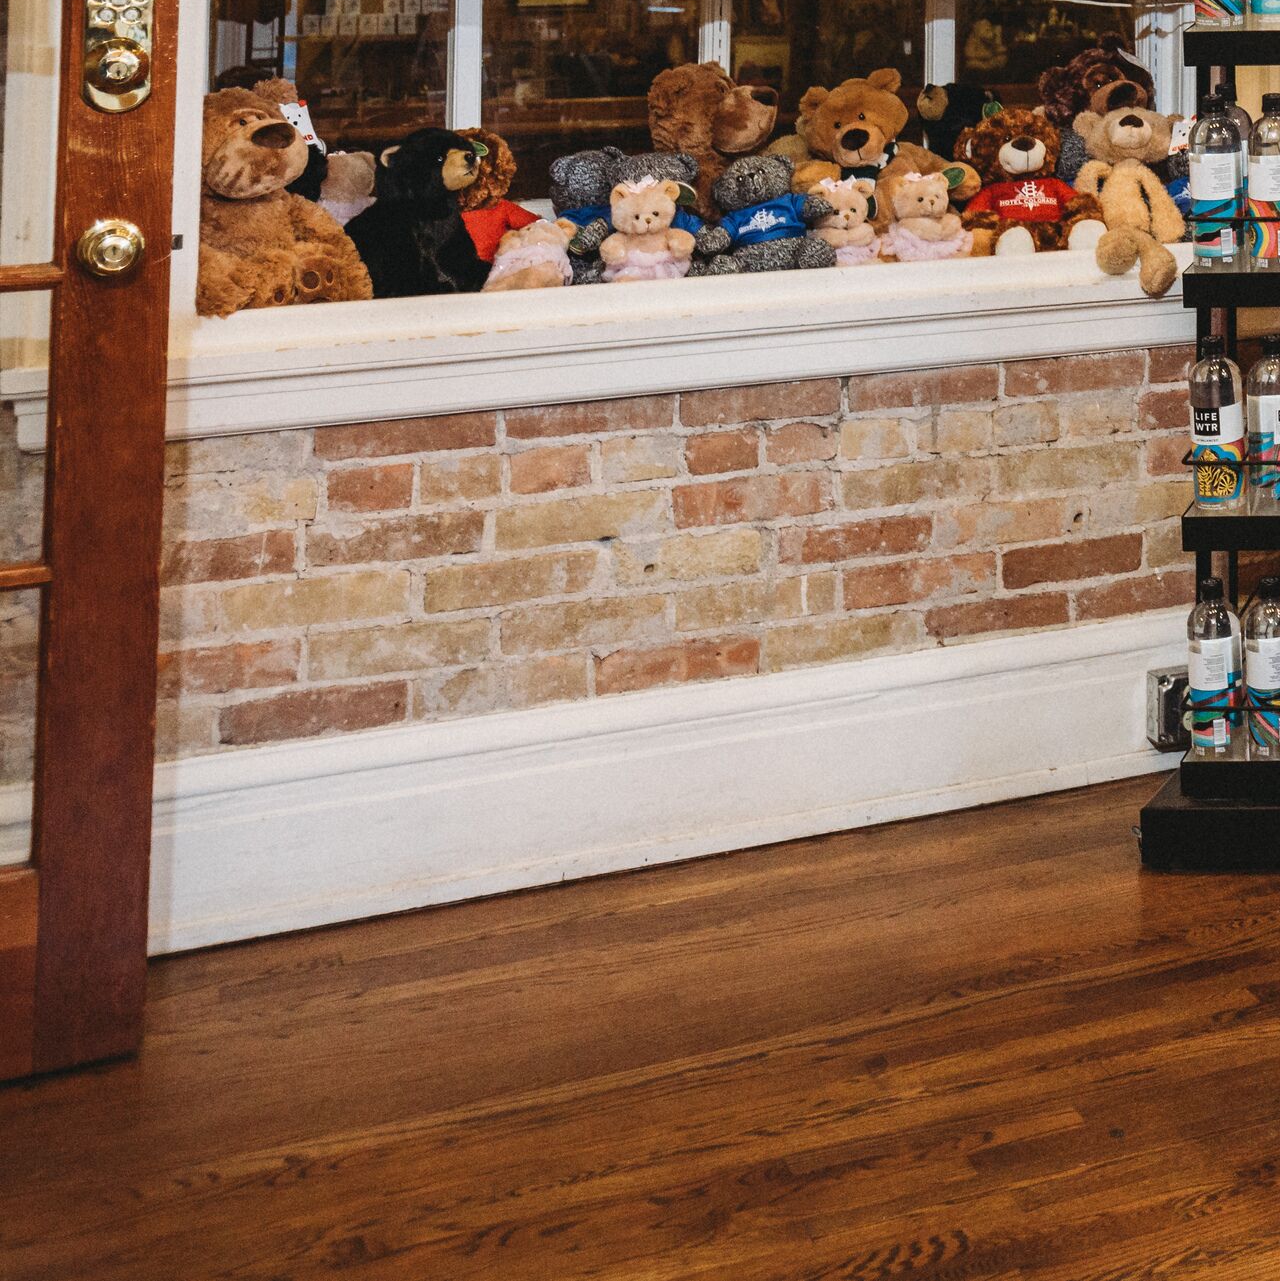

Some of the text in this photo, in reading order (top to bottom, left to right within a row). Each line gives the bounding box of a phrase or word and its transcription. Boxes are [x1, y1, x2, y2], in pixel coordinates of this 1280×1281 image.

[999, 198, 1023, 207] HOTEL
[1195, 412, 1218, 421] LIFE
[1195, 422, 1218, 432] WTR
